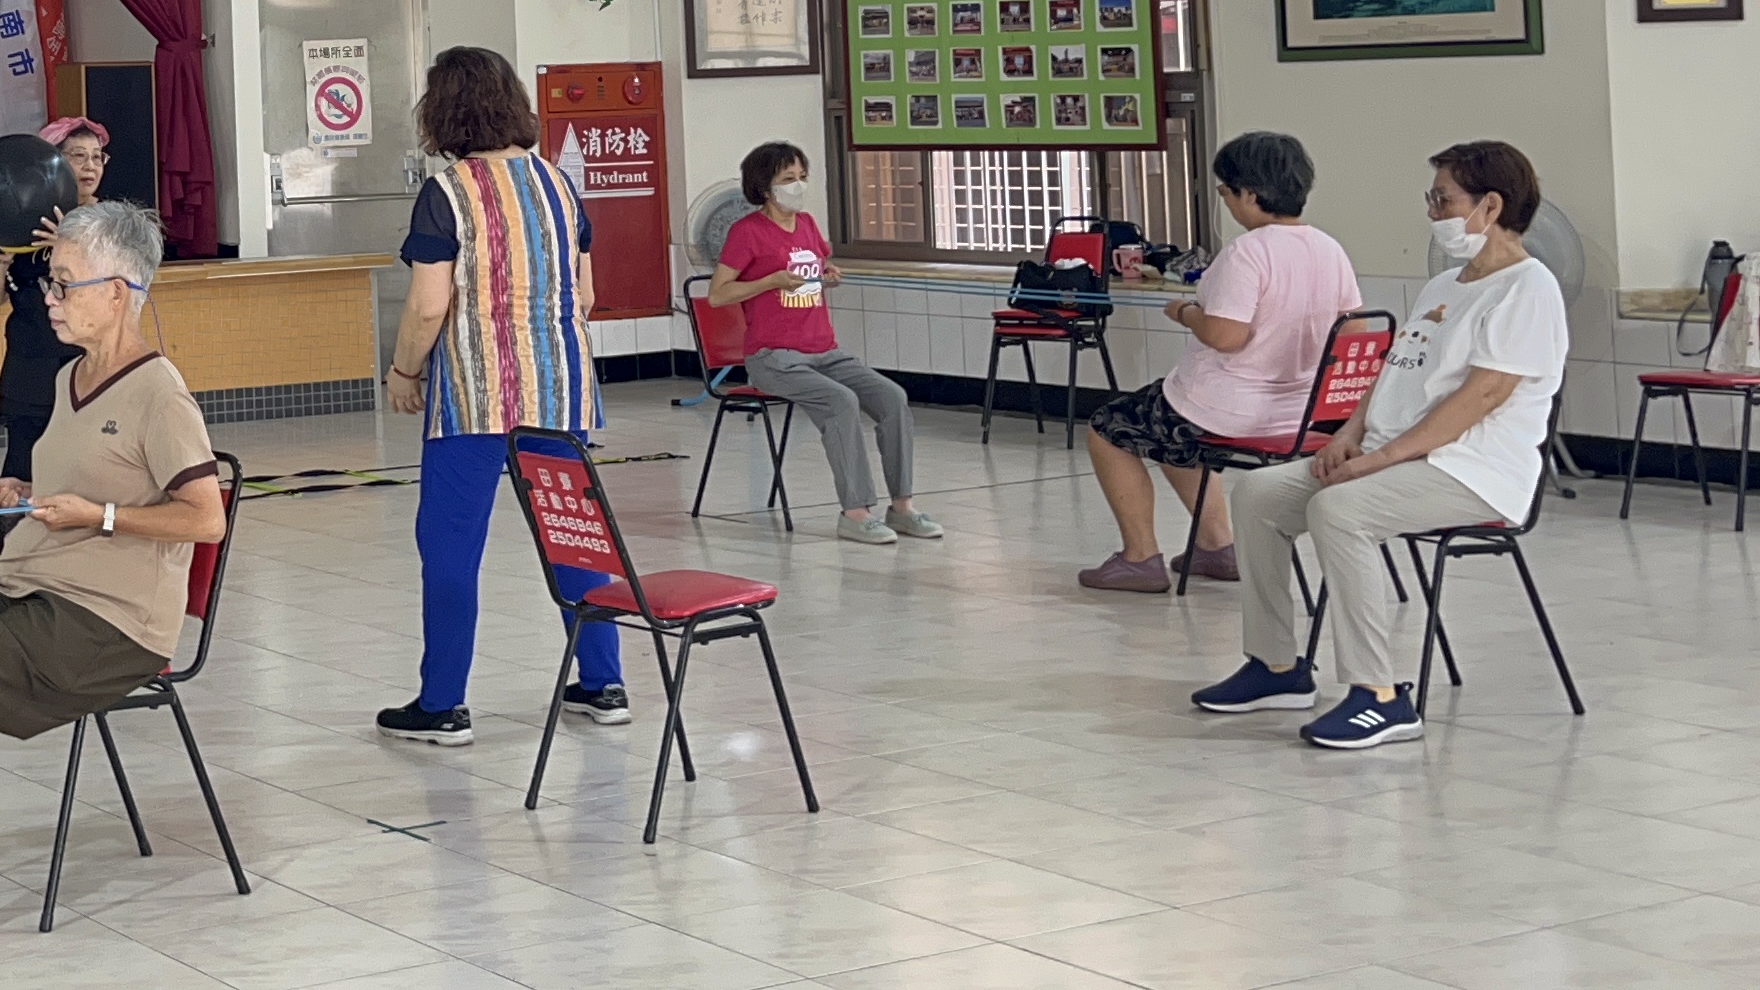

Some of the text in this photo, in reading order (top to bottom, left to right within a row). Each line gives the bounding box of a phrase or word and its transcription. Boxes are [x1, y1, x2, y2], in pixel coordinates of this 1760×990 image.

[582, 127, 650, 157] 消防栓
[590, 170, 649, 187] Hydrant
[547, 529, 611, 554] 2504493
